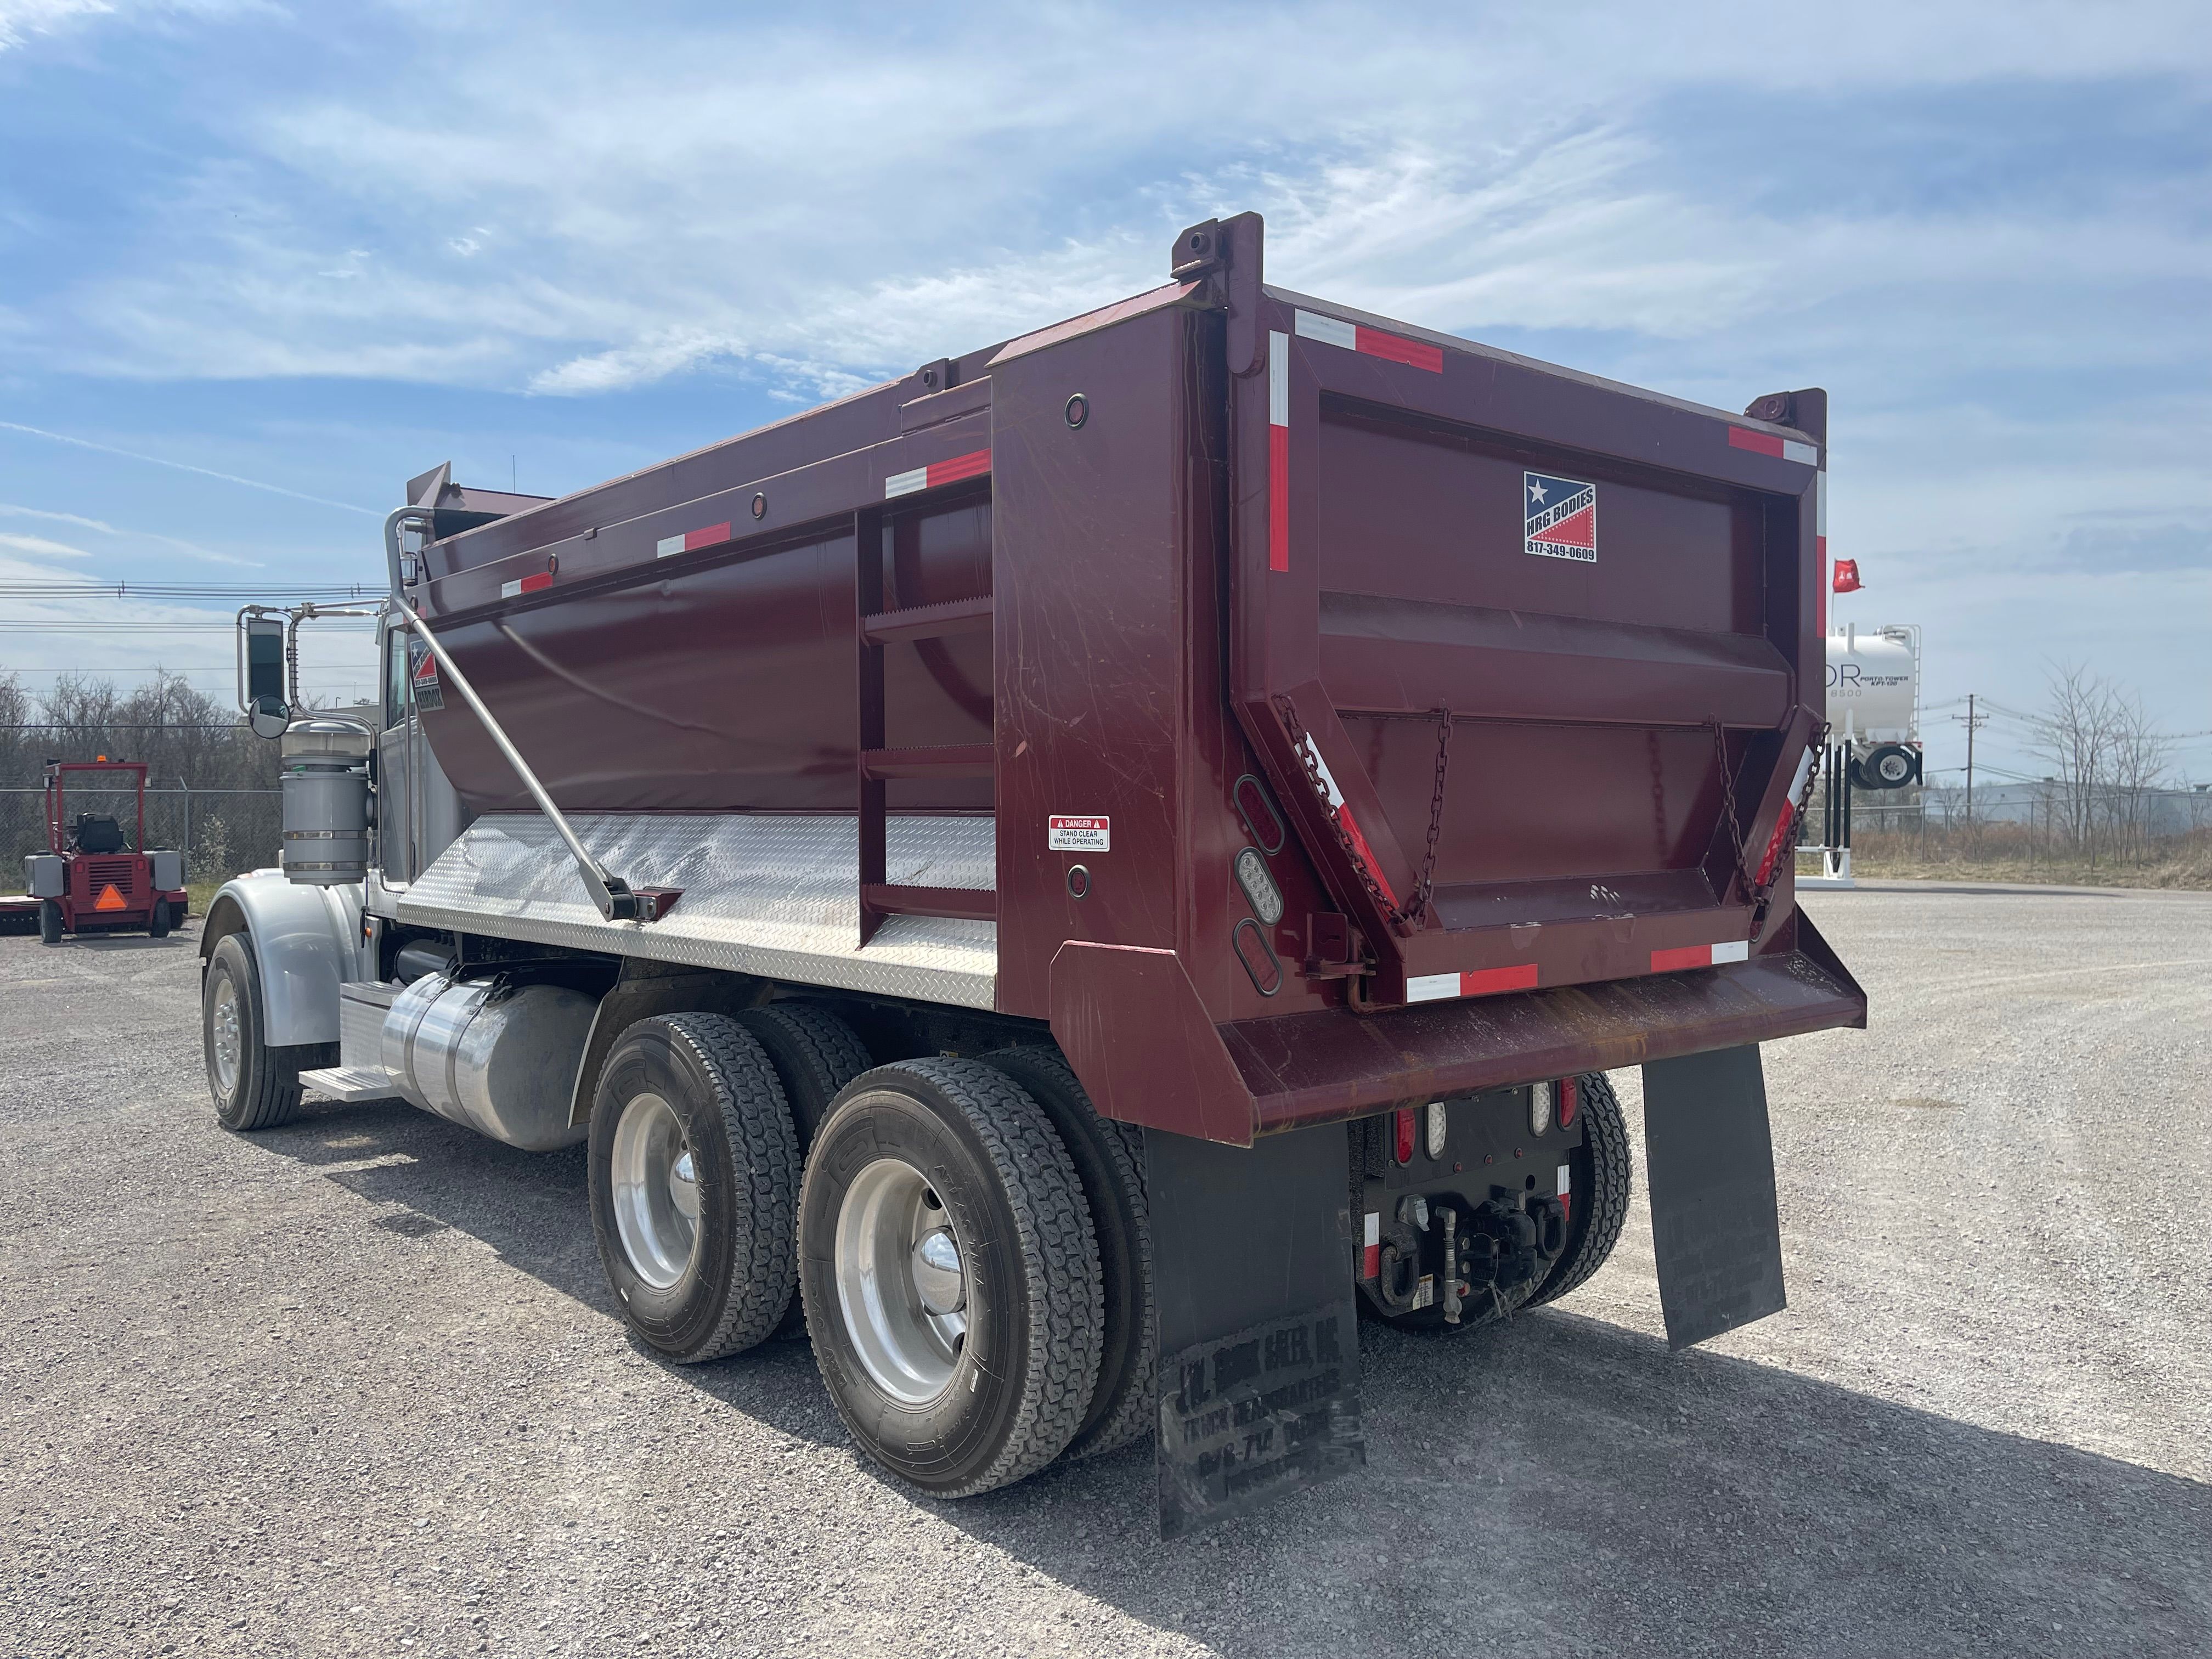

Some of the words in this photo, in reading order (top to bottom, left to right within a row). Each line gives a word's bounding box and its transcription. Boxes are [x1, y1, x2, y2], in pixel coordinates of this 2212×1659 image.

[1527, 511, 1550, 537] HRG
[1553, 488, 1593, 522] BODIES
[1527, 540, 1594, 560] 817-349-0609
[1065, 820, 1092, 828] DANGER
